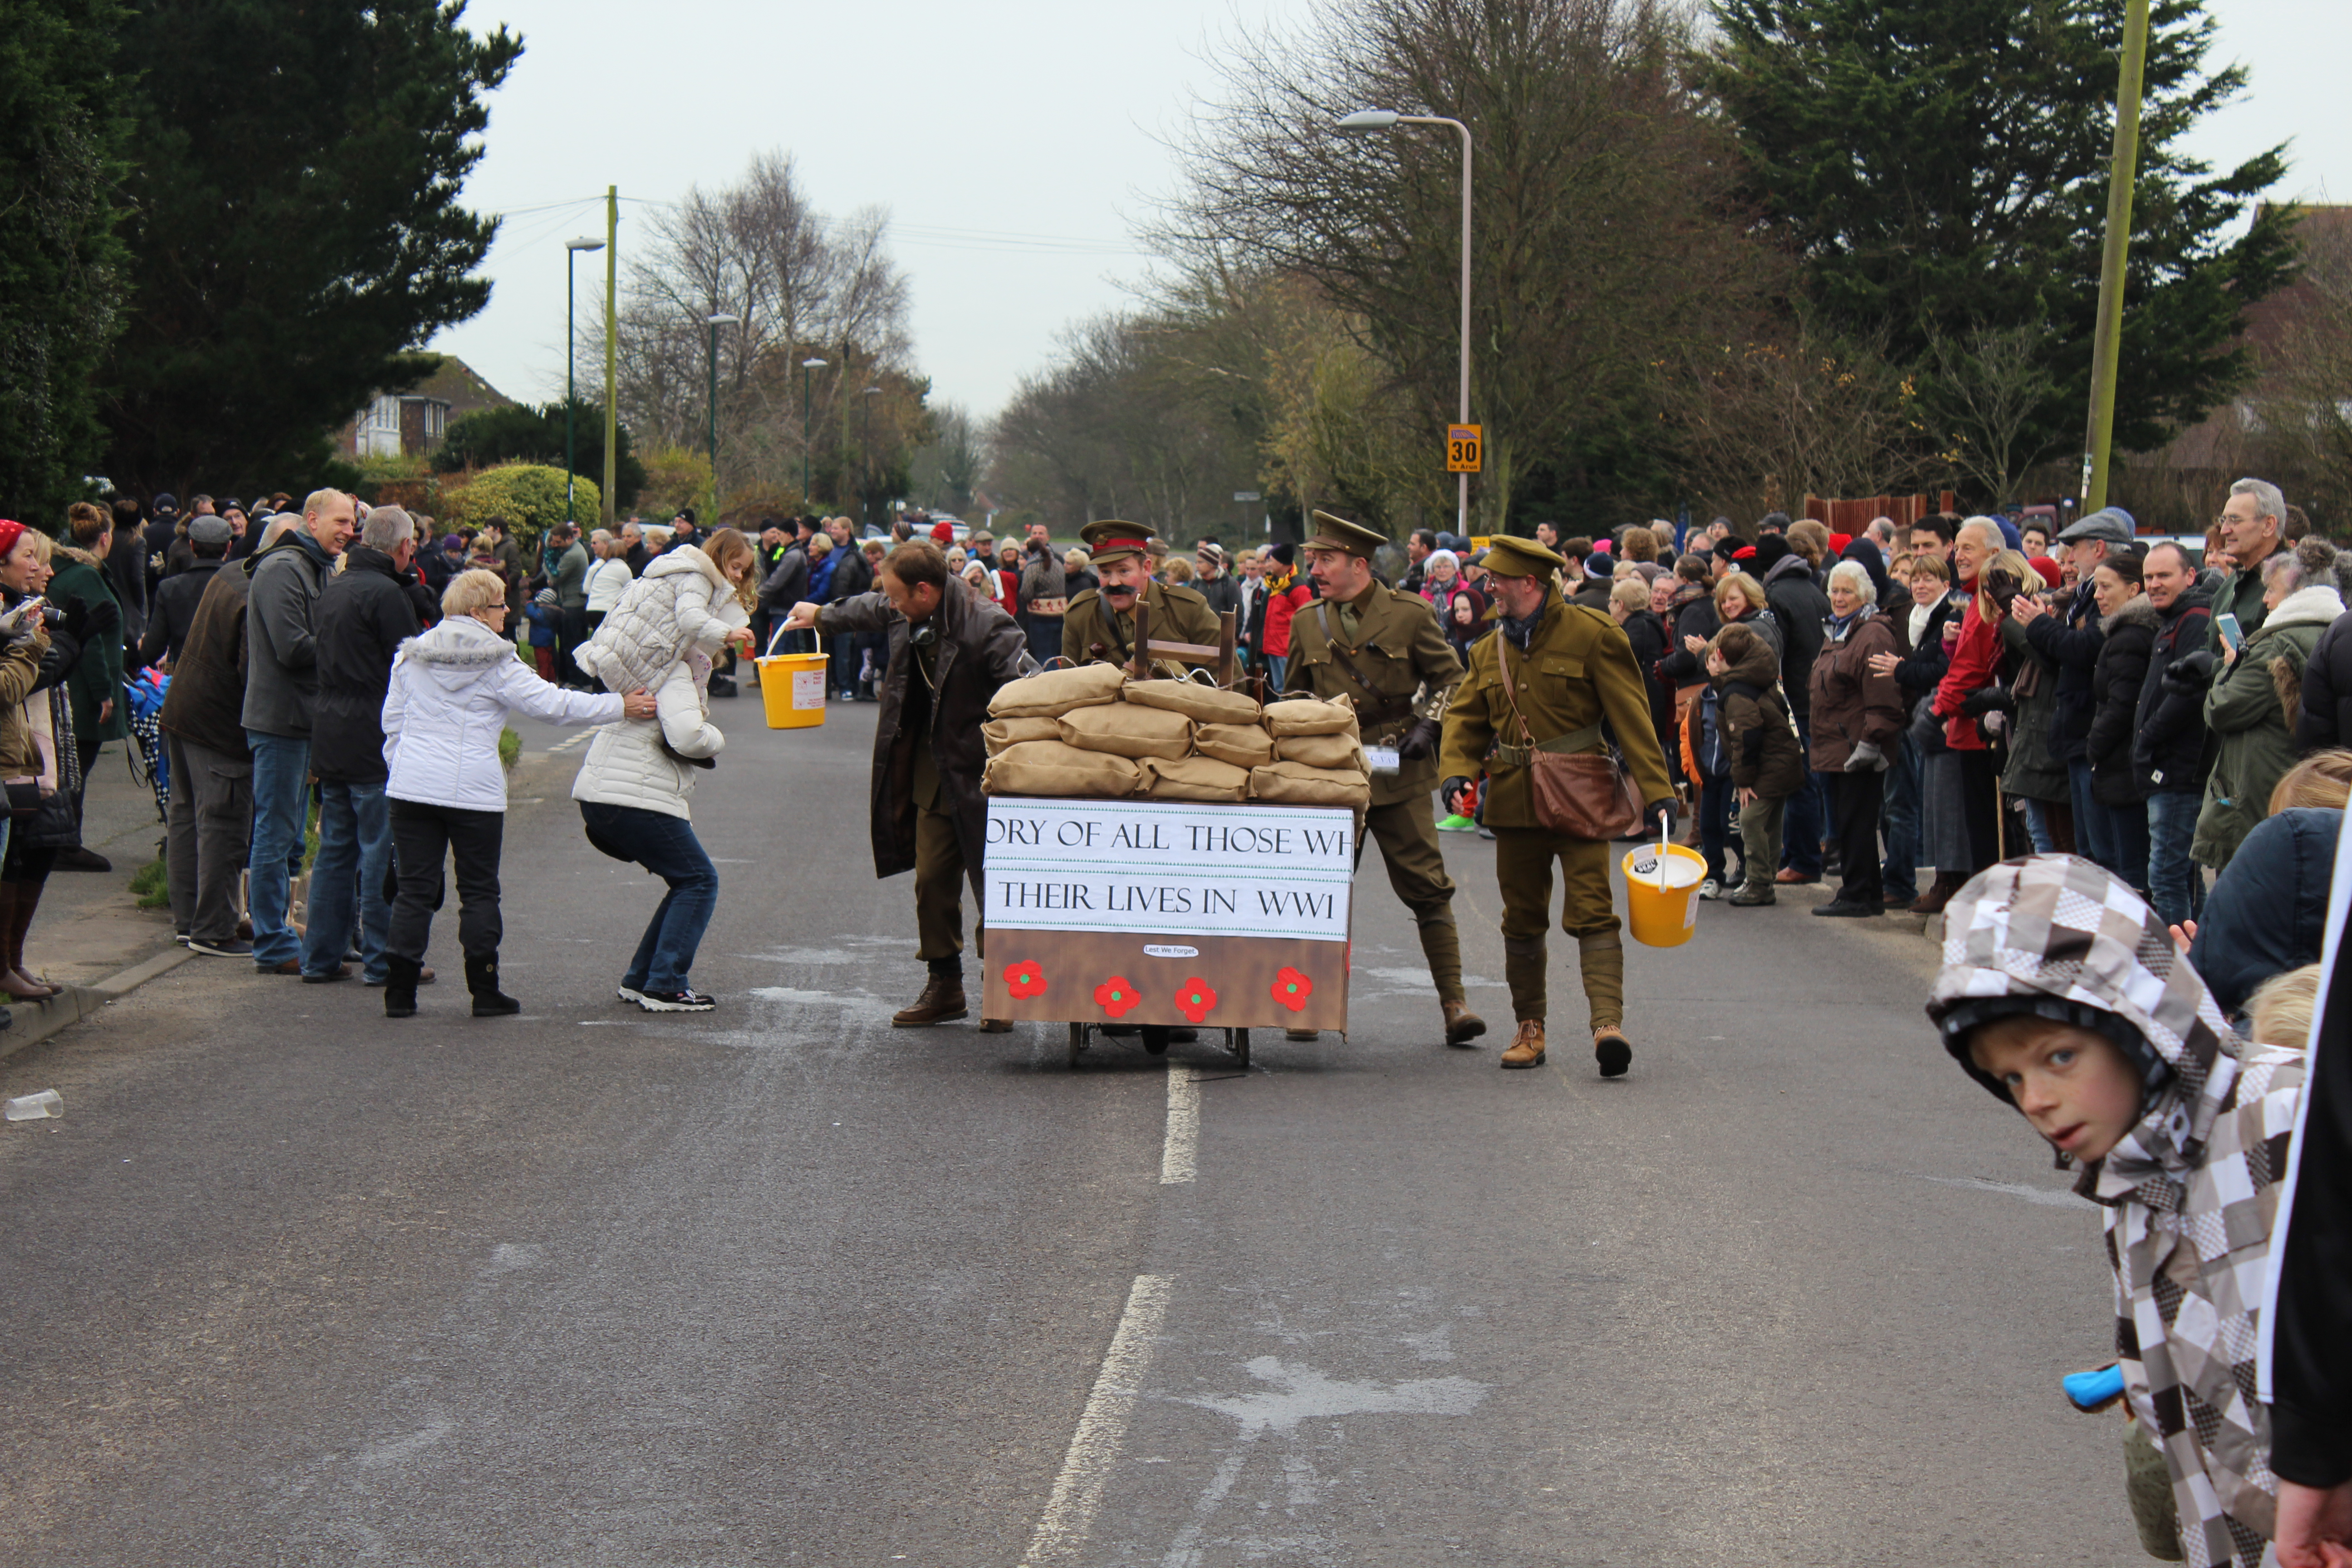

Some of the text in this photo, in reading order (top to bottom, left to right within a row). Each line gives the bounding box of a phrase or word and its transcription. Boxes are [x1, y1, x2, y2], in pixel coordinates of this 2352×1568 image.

[1452, 441, 1476, 462] 30
[1058, 821, 1102, 847] OF
[1111, 823, 1170, 850] ALL
[1185, 824, 1292, 854] THOSE
[999, 881, 1097, 910] THEIR
[1107, 885, 1192, 913] LIVES
[1202, 888, 1237, 914] IN
